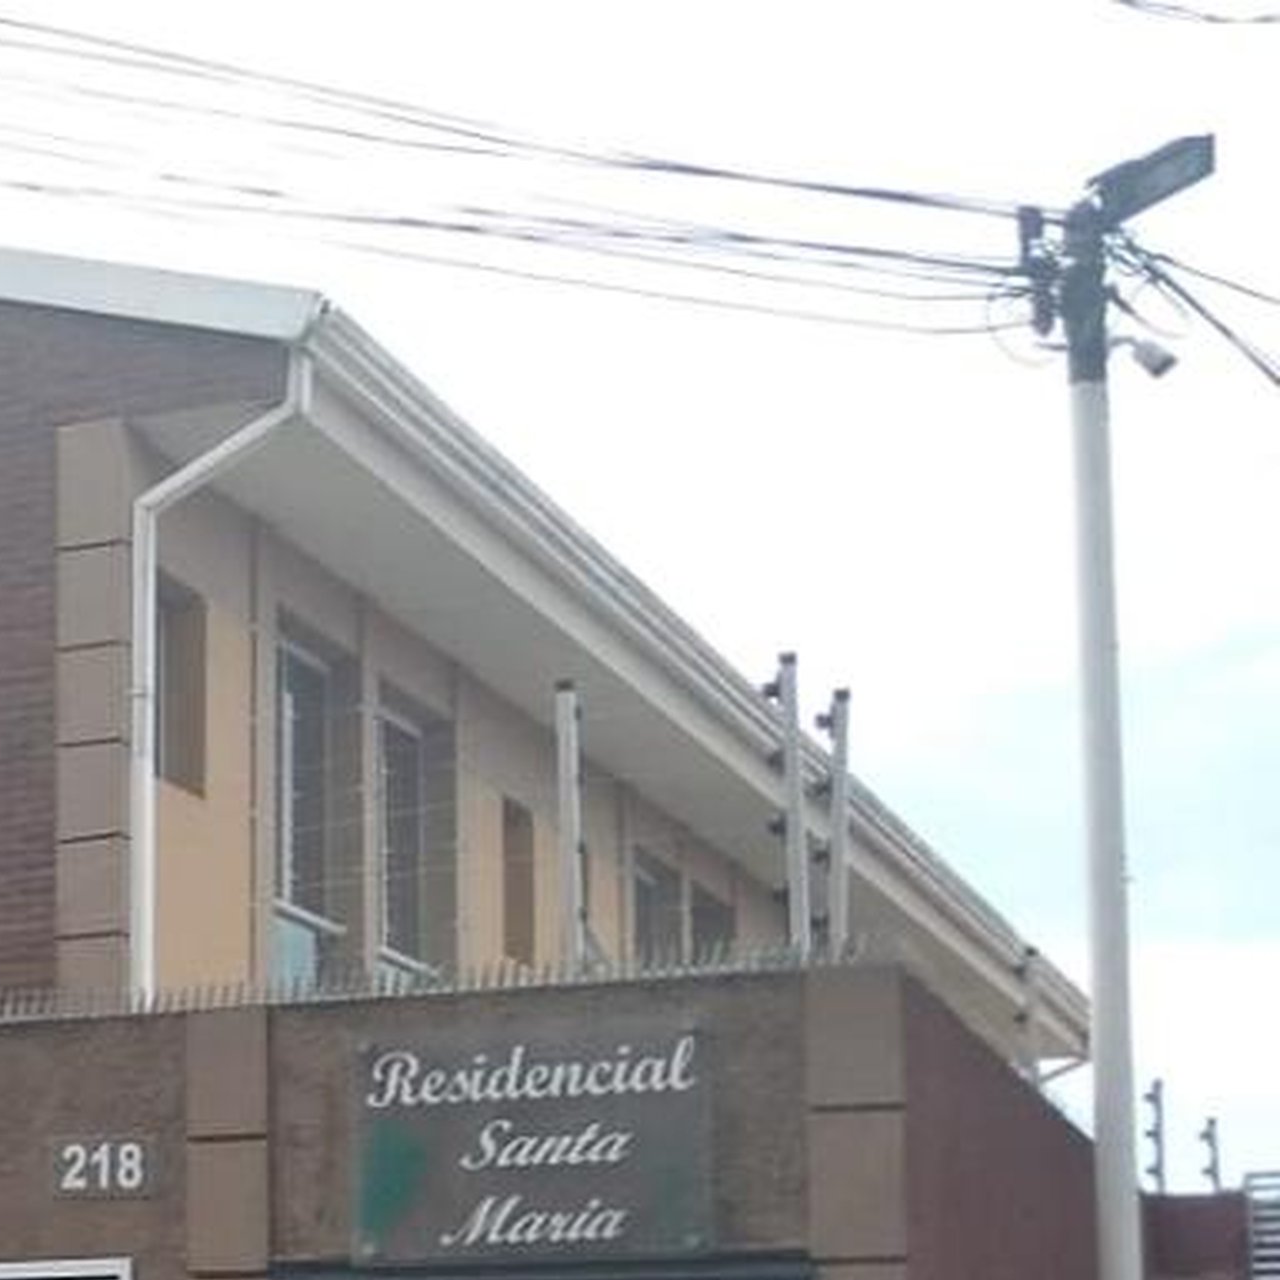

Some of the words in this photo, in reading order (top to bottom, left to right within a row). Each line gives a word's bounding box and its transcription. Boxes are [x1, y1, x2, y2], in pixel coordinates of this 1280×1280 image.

[367, 1036, 695, 1108] Residencial
[60, 1142, 143, 1190] 218
[459, 1119, 634, 1171] Santa
[440, 1195, 628, 1246] Maria
